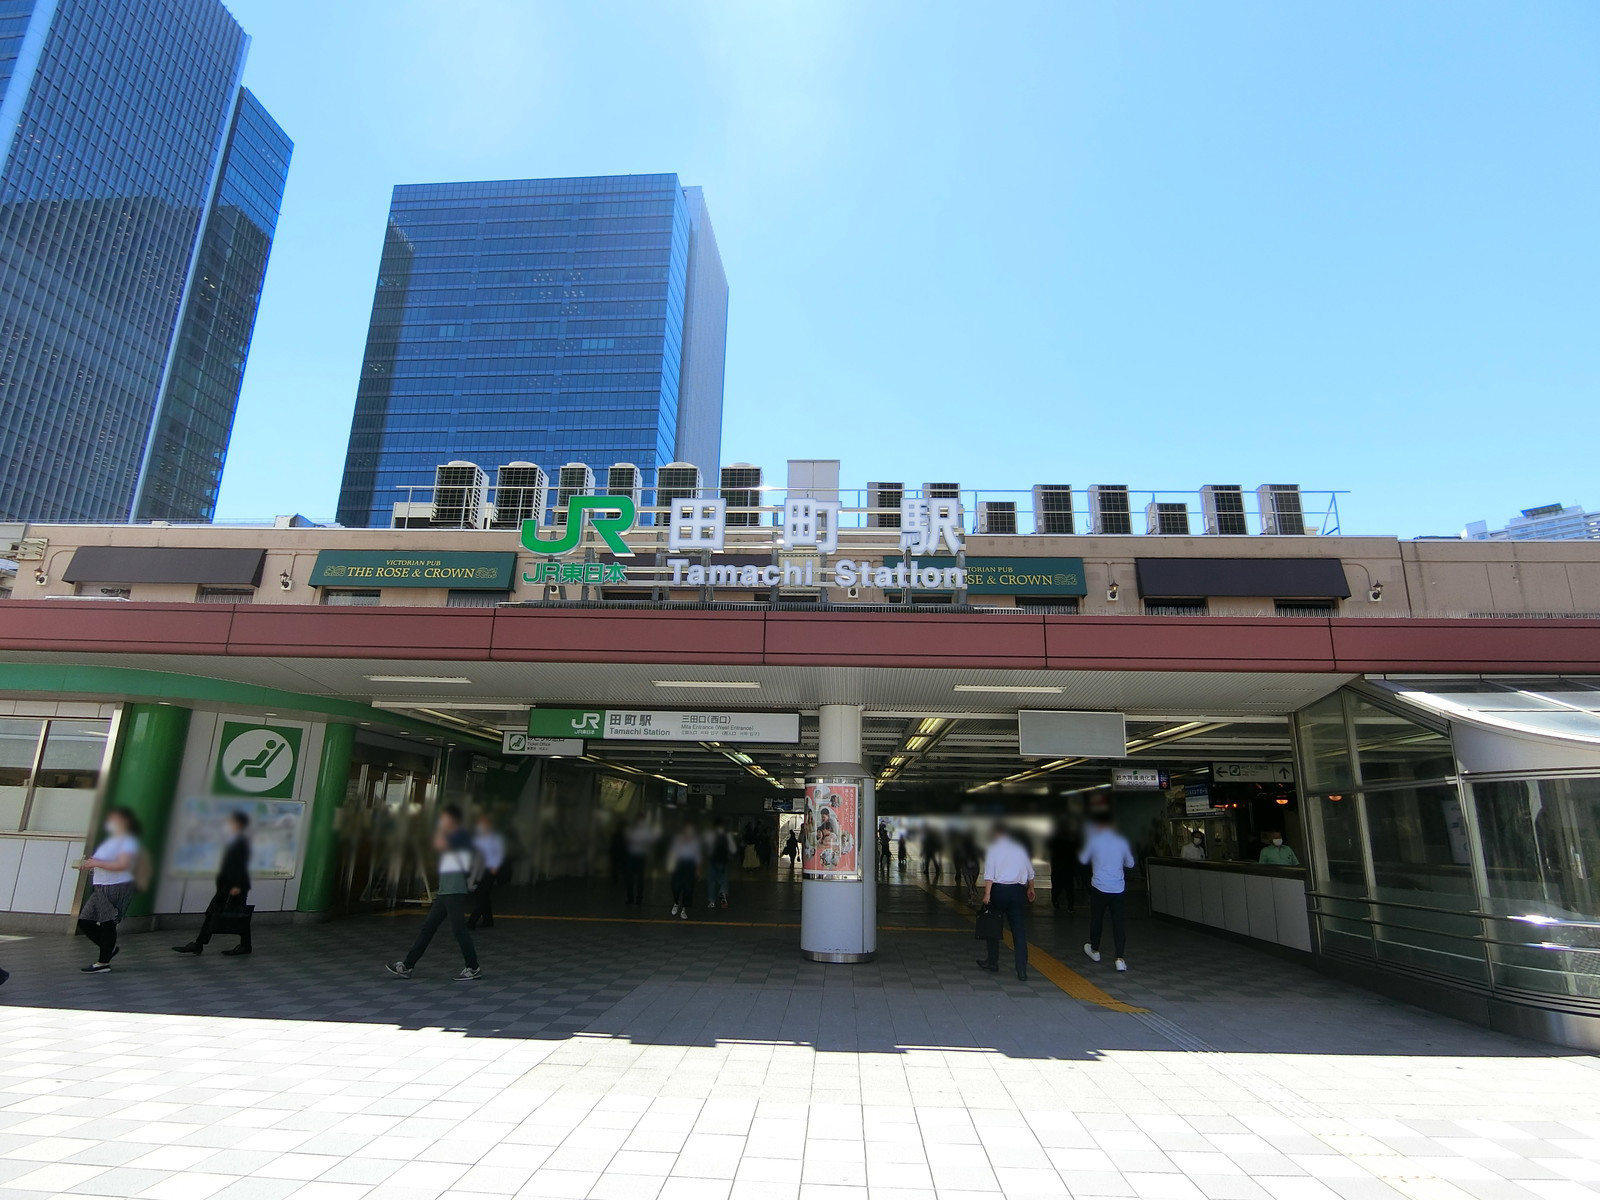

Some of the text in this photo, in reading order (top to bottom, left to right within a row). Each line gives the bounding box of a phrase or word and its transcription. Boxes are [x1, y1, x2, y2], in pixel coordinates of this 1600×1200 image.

[521, 495, 637, 557] JR
[668, 497, 962, 557] 田町駅
[347, 566, 476, 579] THE ROSE & CROWN
[522, 562, 627, 584] JR東日本
[666, 558, 965, 588] Tamachi Station
[986, 575, 997, 585] &
[999, 574, 1053, 586] CROWN
[571, 712, 600, 729] JR
[609, 713, 652, 727] 田町駅
[609, 727, 671, 736] Tamachi Station
